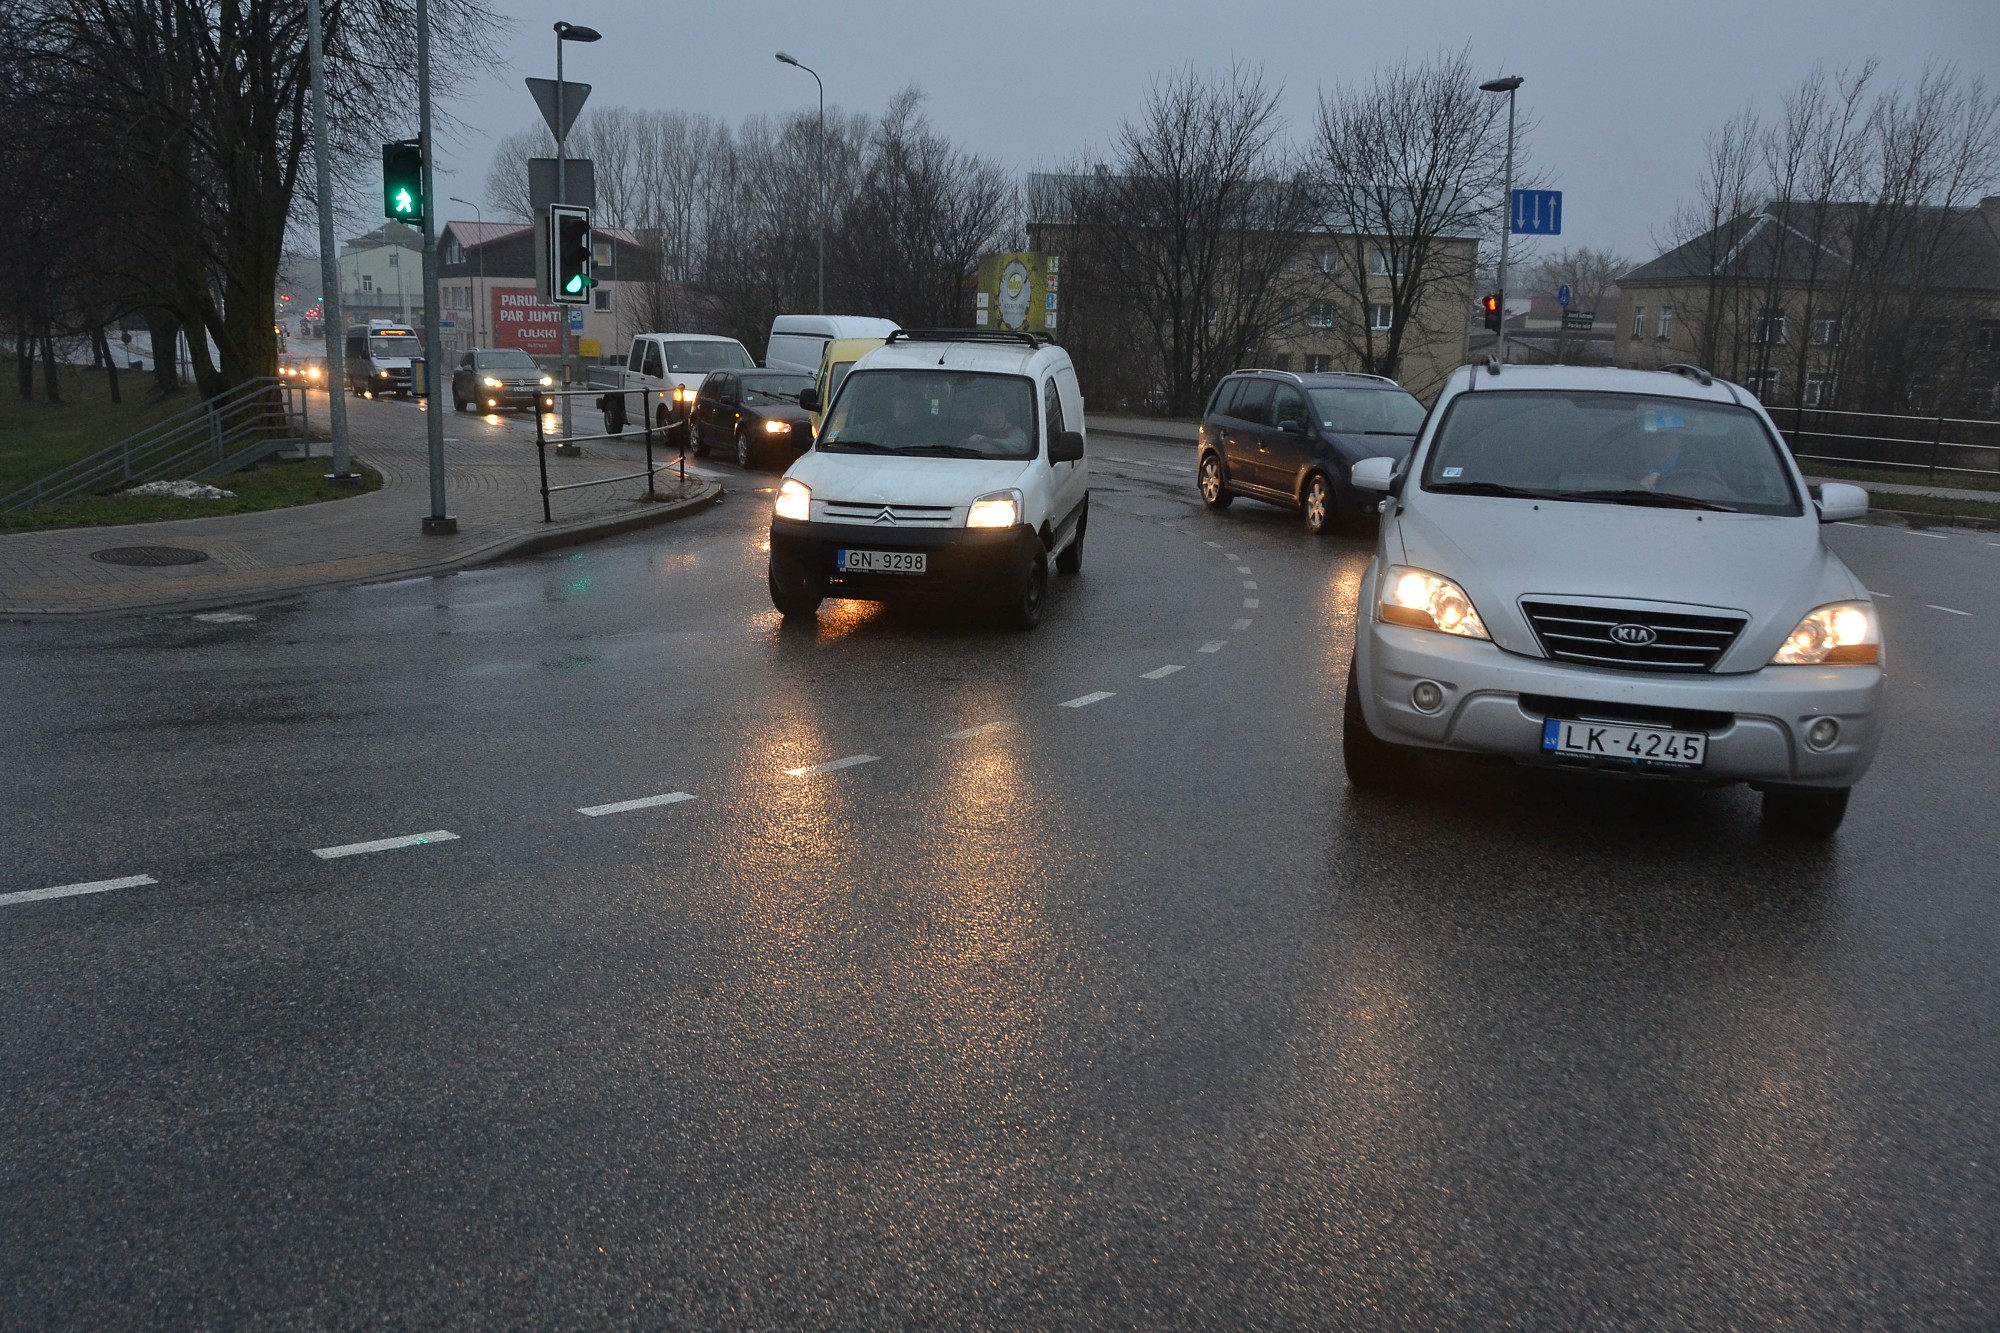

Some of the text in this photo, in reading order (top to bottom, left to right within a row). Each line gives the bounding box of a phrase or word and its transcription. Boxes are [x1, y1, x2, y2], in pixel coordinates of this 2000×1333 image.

[500, 310, 524, 322] PAR
[849, 552, 923, 569] GN-9298
[1618, 628, 1649, 641] KIA
[1545, 736, 1557, 745] LV
[1565, 725, 1700, 760] LK-4245
